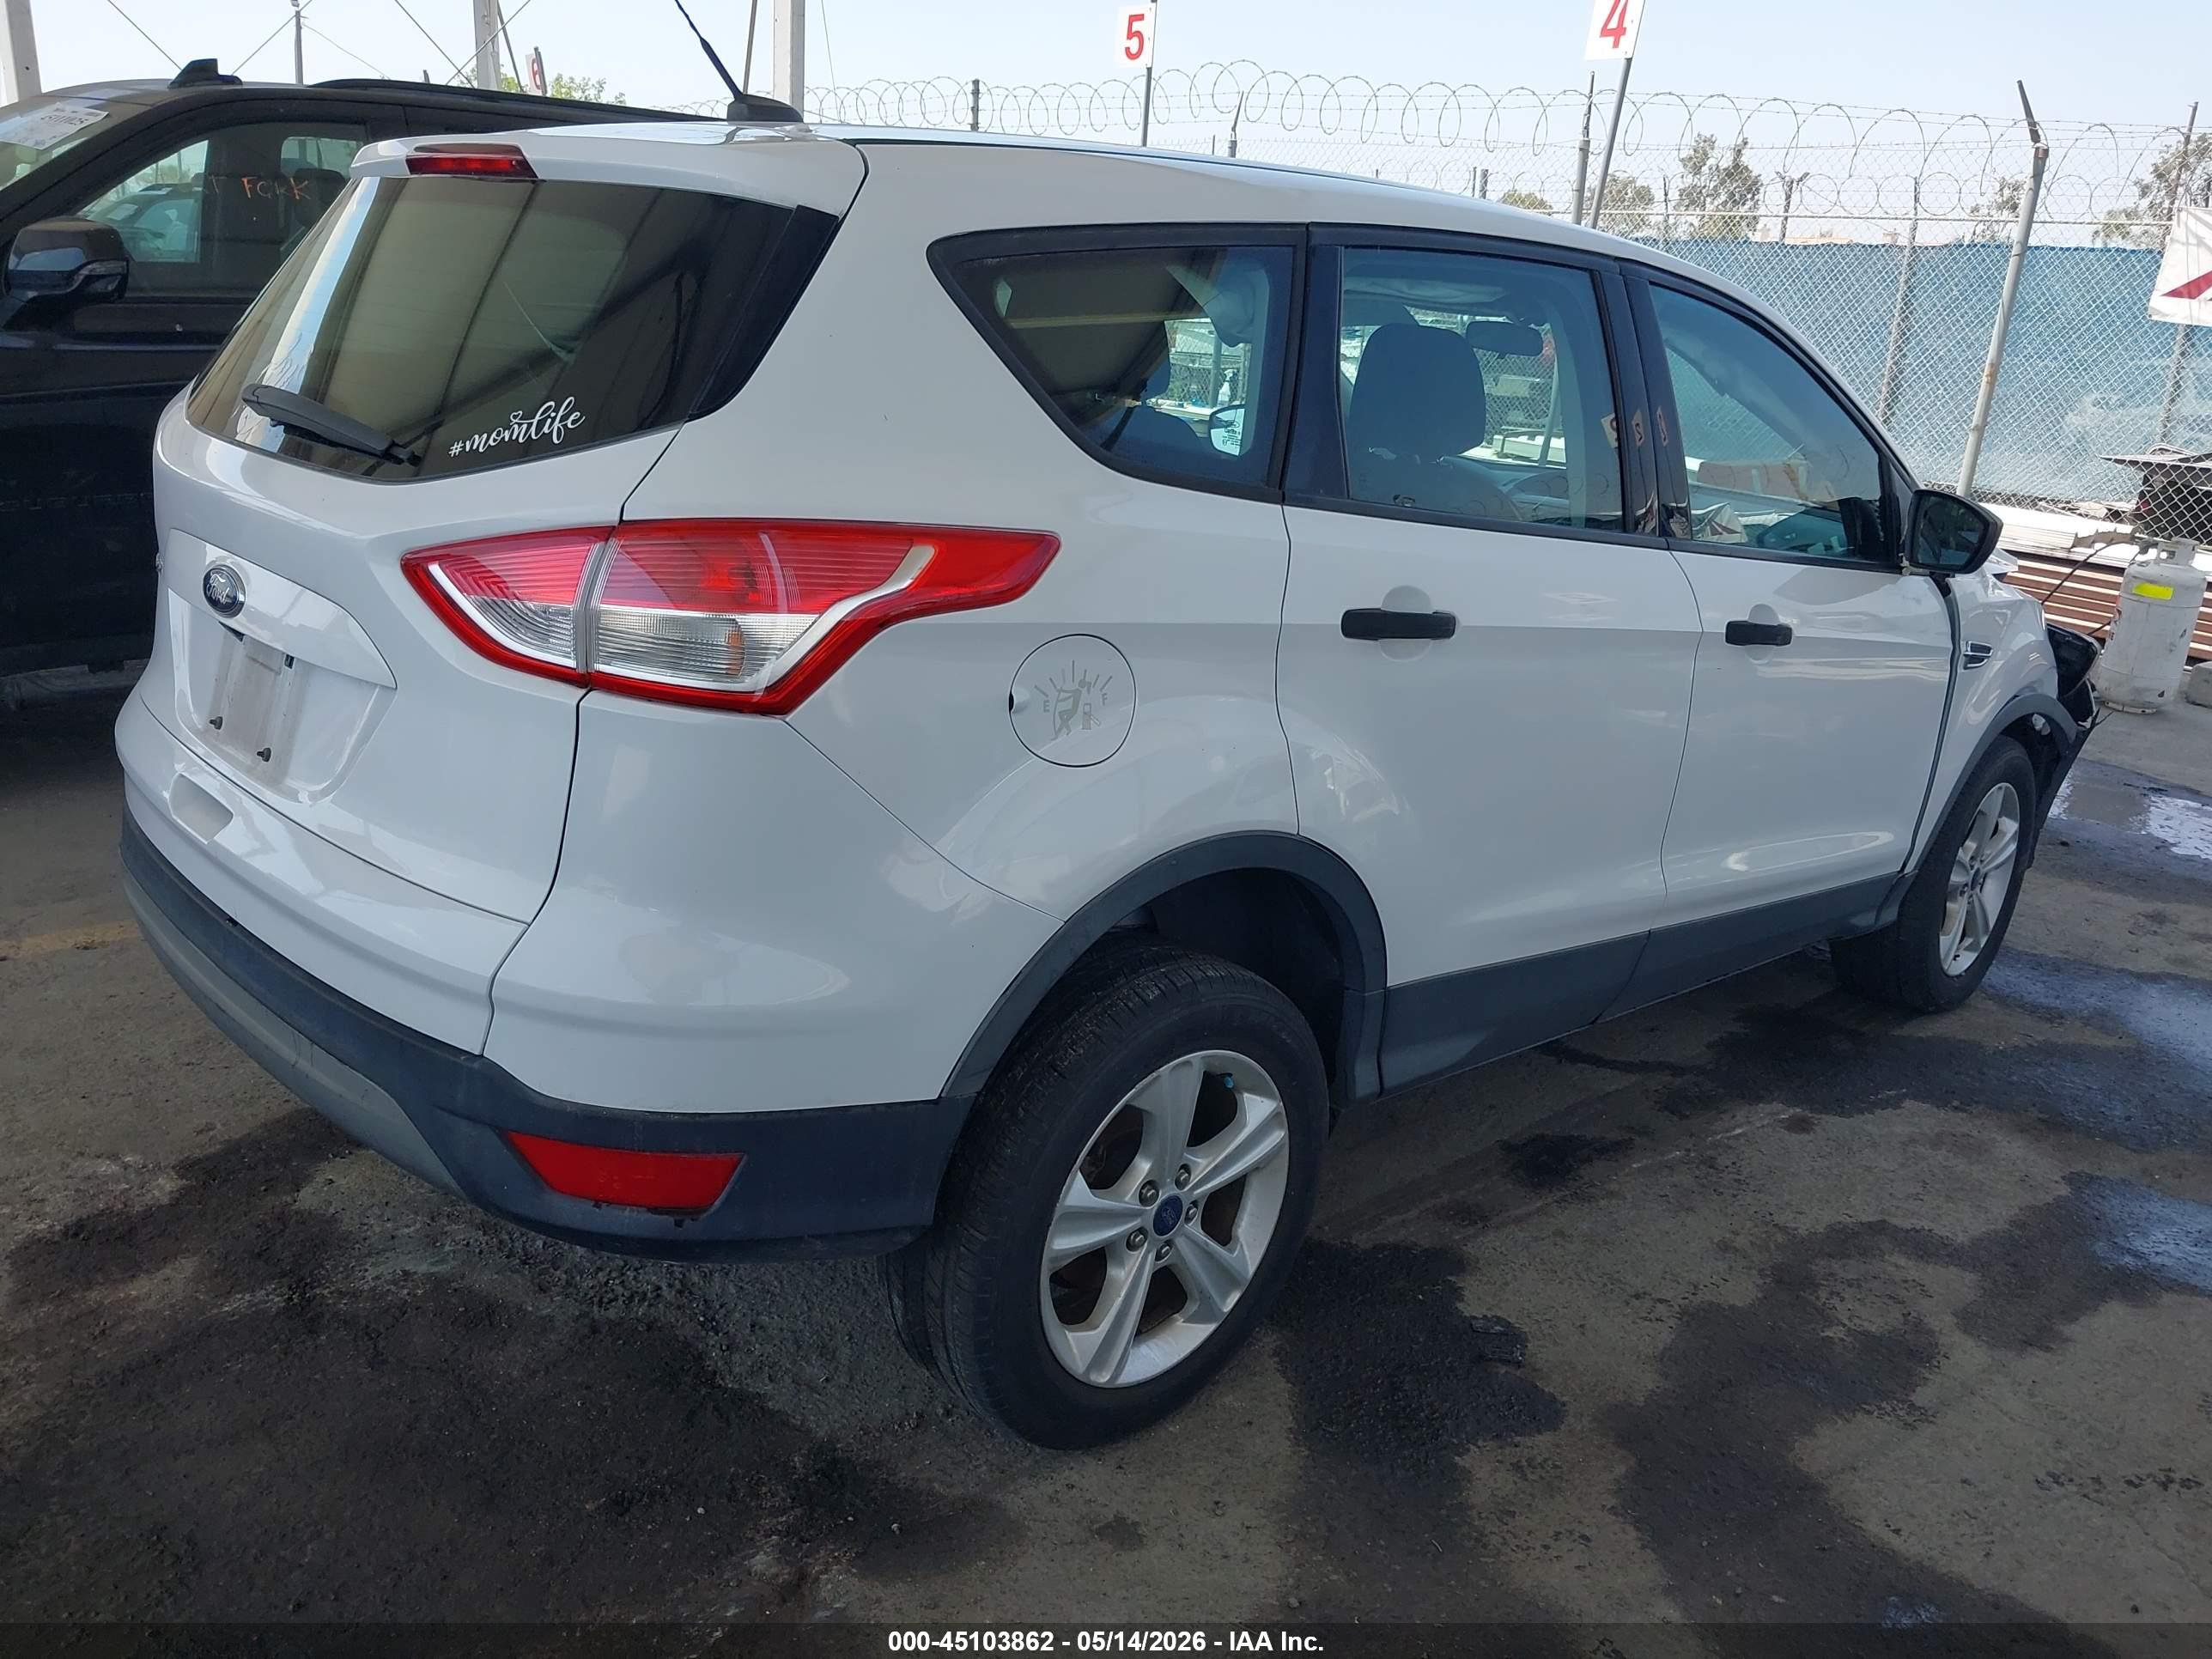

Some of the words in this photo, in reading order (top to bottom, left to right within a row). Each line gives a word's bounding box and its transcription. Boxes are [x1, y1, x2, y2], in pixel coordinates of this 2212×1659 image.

[1125, 13, 1145, 61] 5
[1599, 0, 1629, 49] 4
[448, 396, 586, 458] #momlife
[206, 569, 231, 605] Ford
